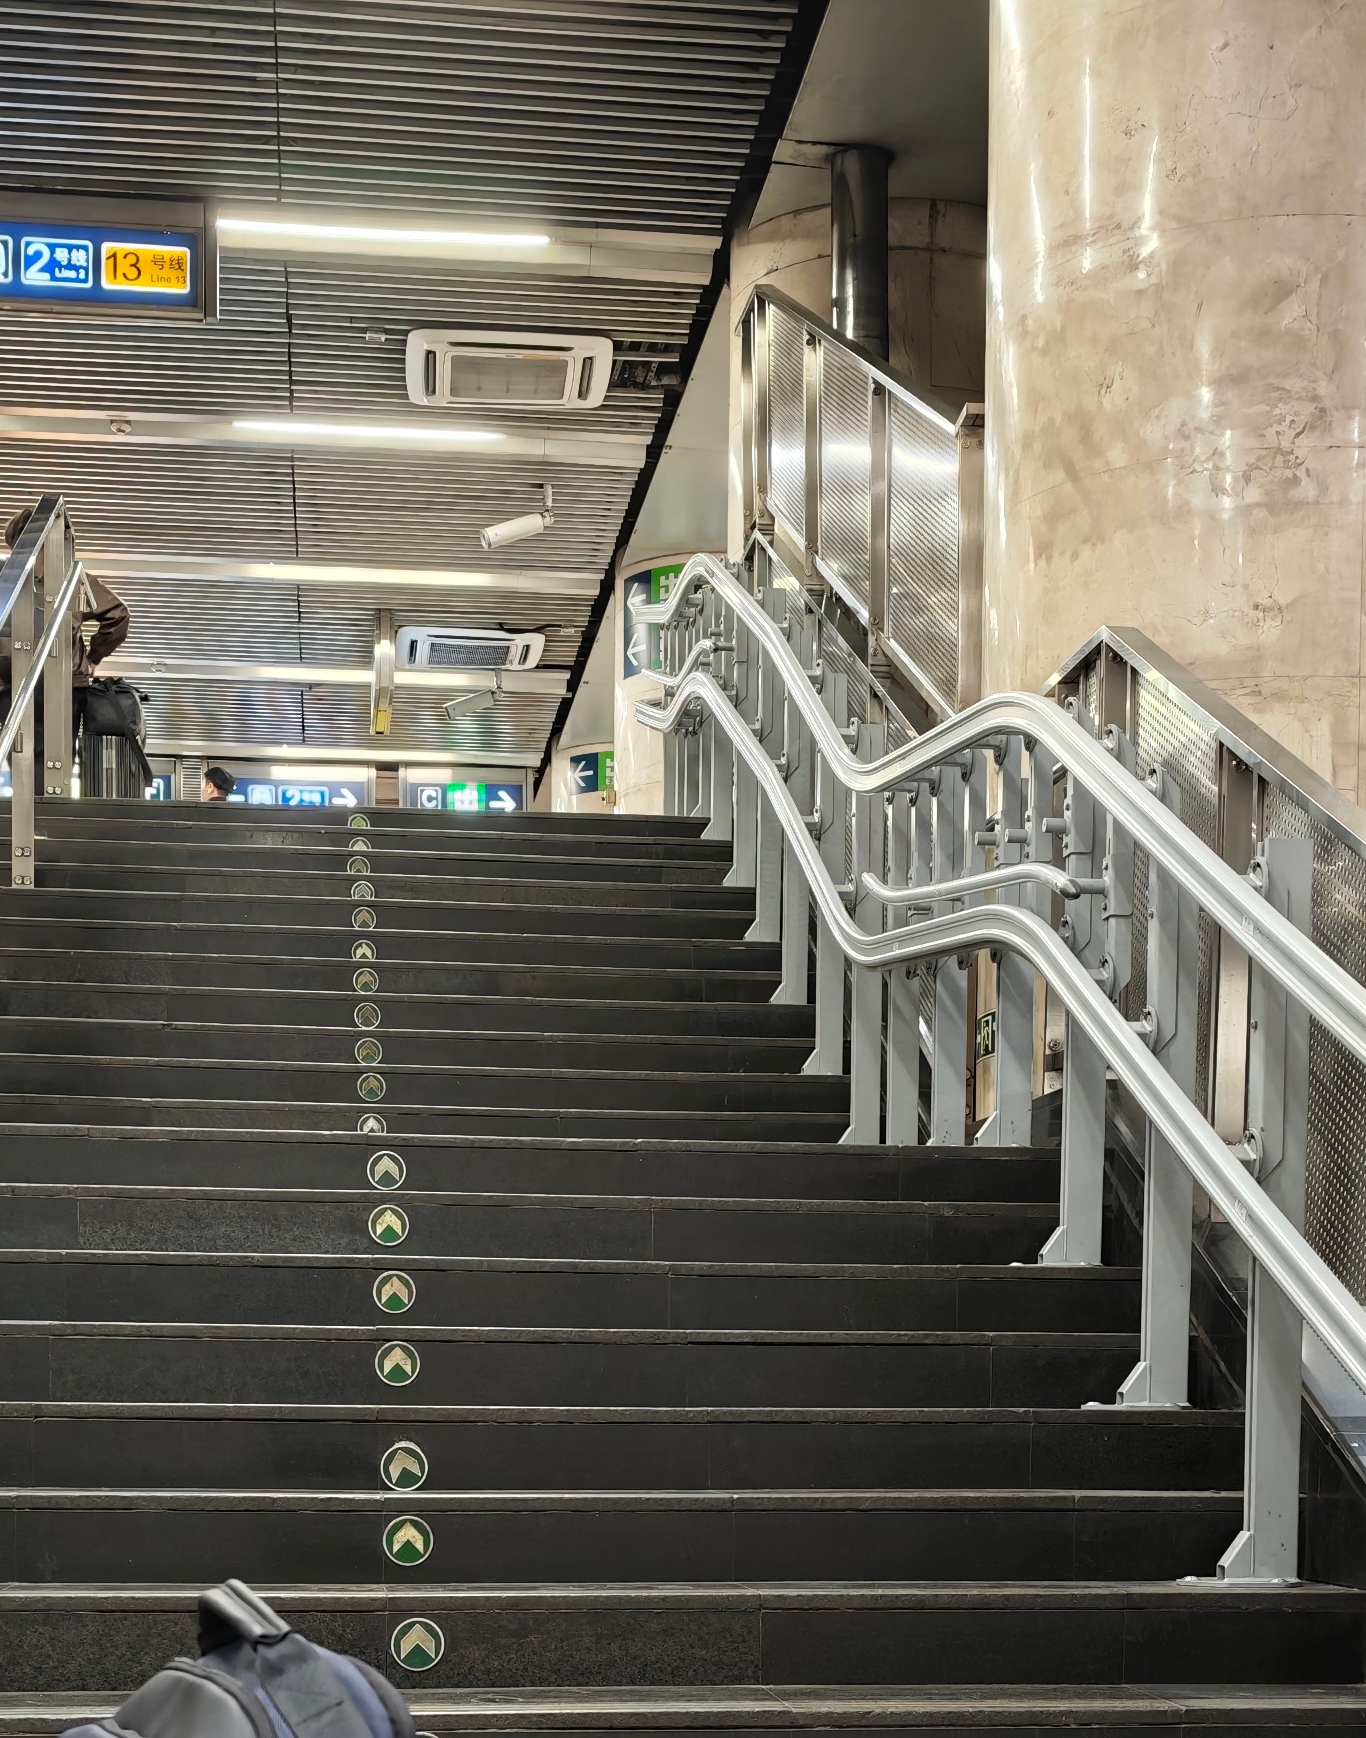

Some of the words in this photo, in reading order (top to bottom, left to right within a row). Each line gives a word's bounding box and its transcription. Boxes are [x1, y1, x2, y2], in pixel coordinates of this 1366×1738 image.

[150, 274, 172, 284] Line
[175, 275, 186, 285] 13
[421, 789, 437, 808] C
